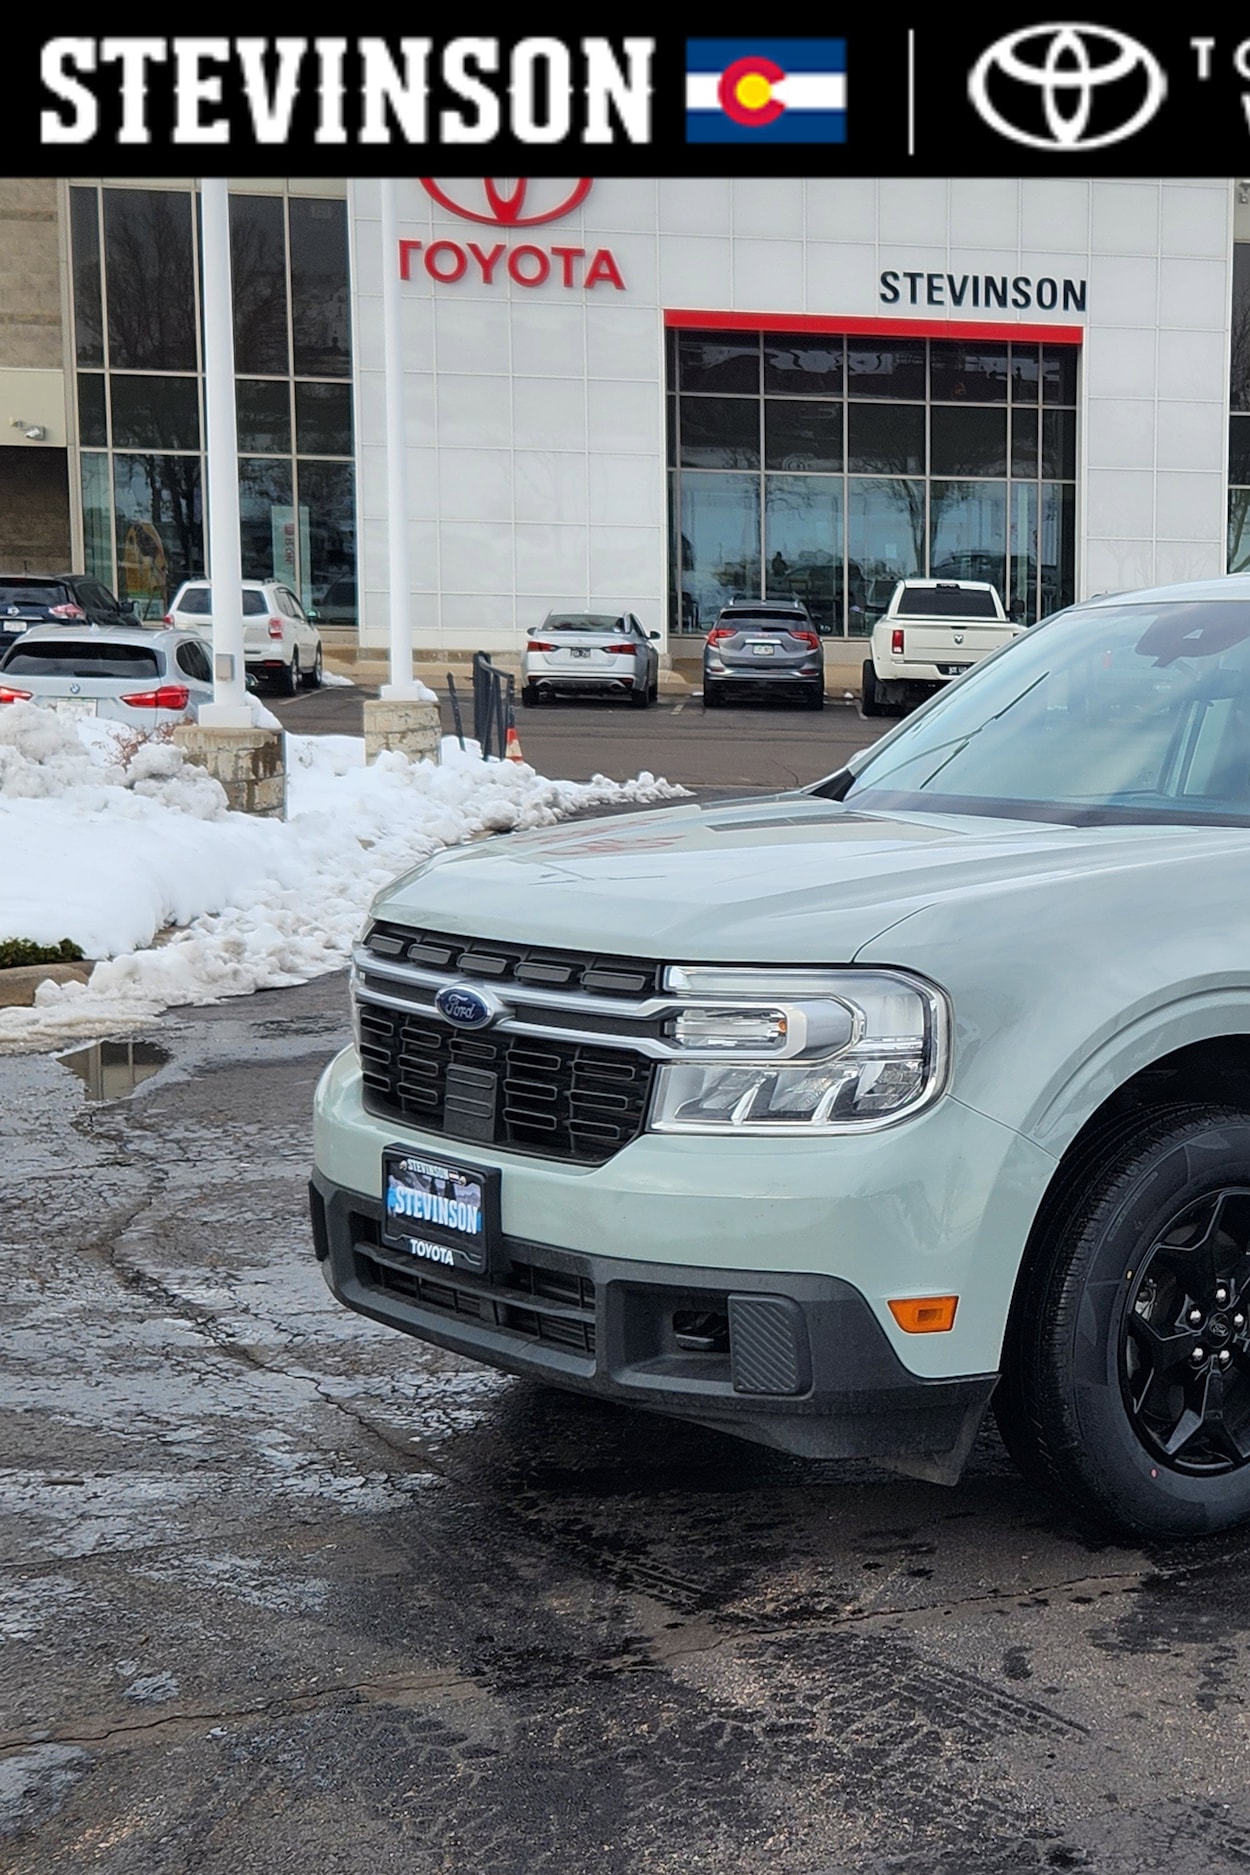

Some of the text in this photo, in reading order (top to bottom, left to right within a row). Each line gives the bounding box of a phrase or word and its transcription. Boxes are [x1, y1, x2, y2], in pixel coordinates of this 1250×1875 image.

[398, 239, 626, 290] TOYOTA
[879, 270, 1087, 312] STEVINSON
[445, 993, 477, 1019] Ford
[406, 1158, 450, 1181] STEVINSON
[394, 1185, 479, 1235] STEVINSON
[410, 1238, 455, 1266] TOYOTA
